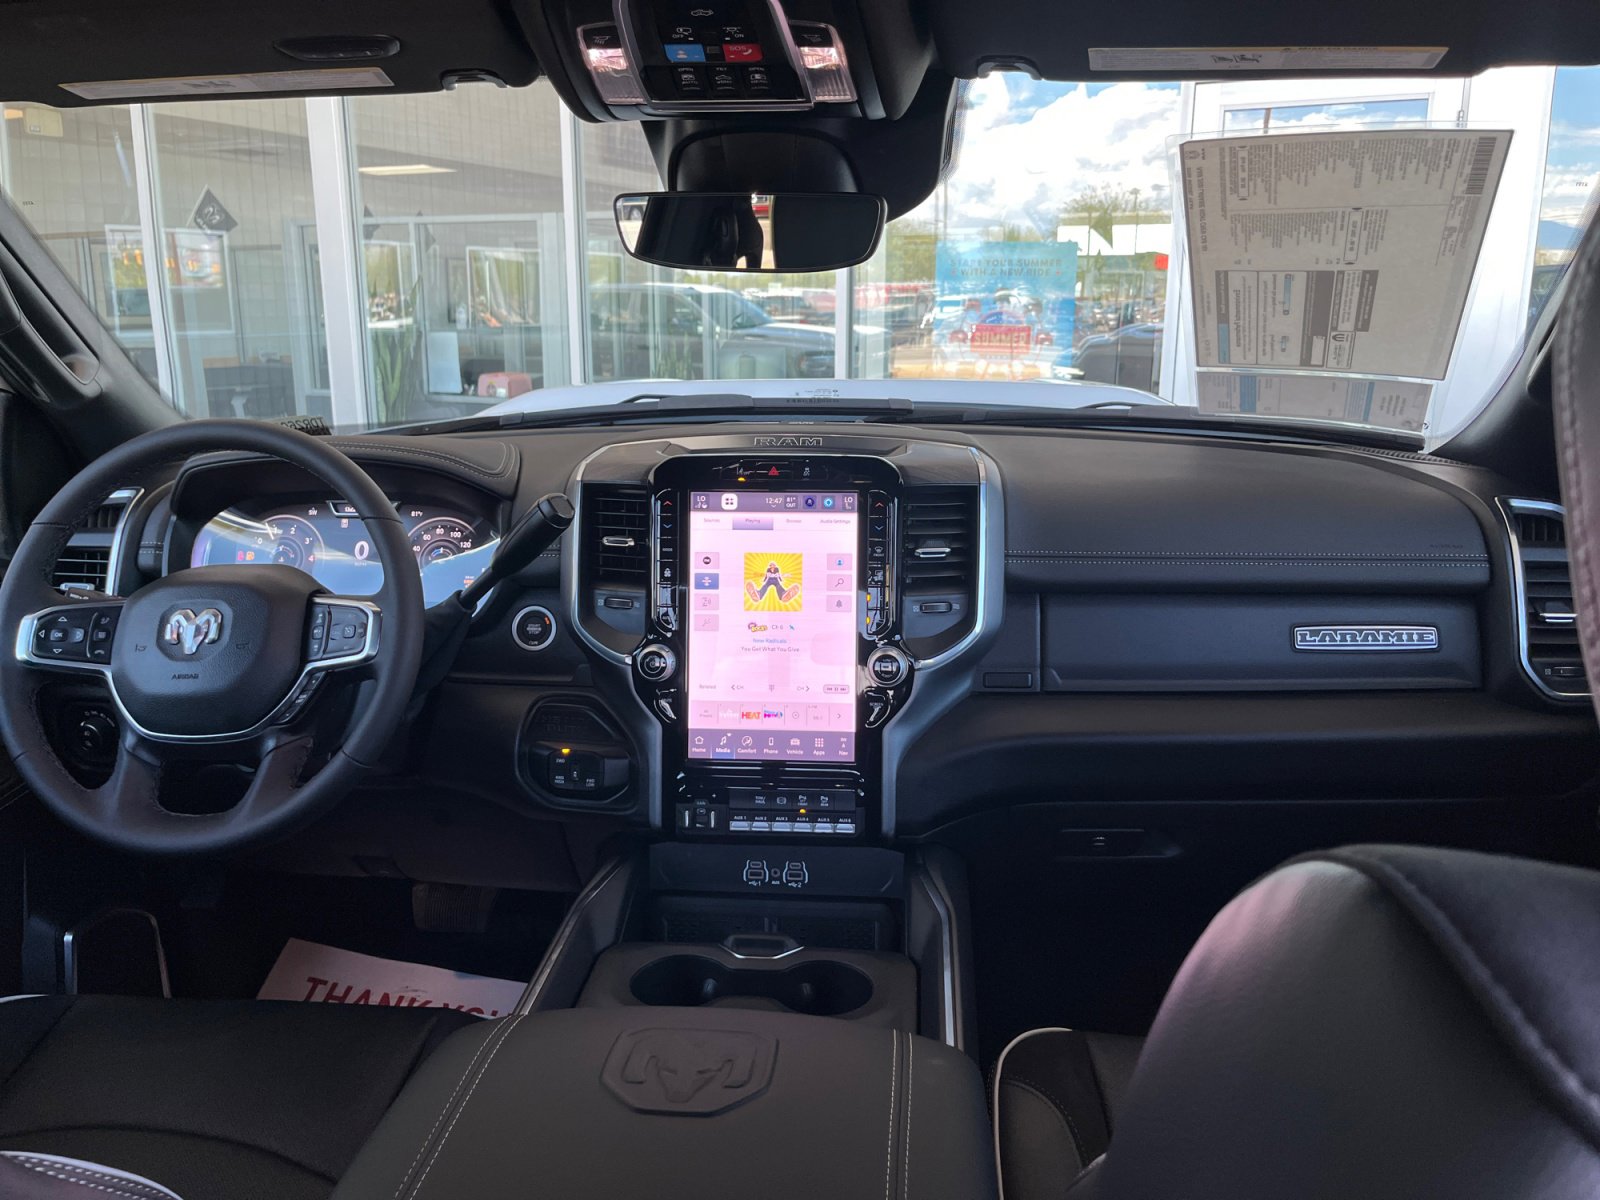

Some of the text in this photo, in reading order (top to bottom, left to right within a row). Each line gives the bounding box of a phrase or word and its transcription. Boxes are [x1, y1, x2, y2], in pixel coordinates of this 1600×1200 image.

[975, 332, 1026, 345] SUMMER
[754, 437, 822, 446] RAM
[354, 540, 369, 560] 0
[1296, 631, 1436, 644] LARAMIE
